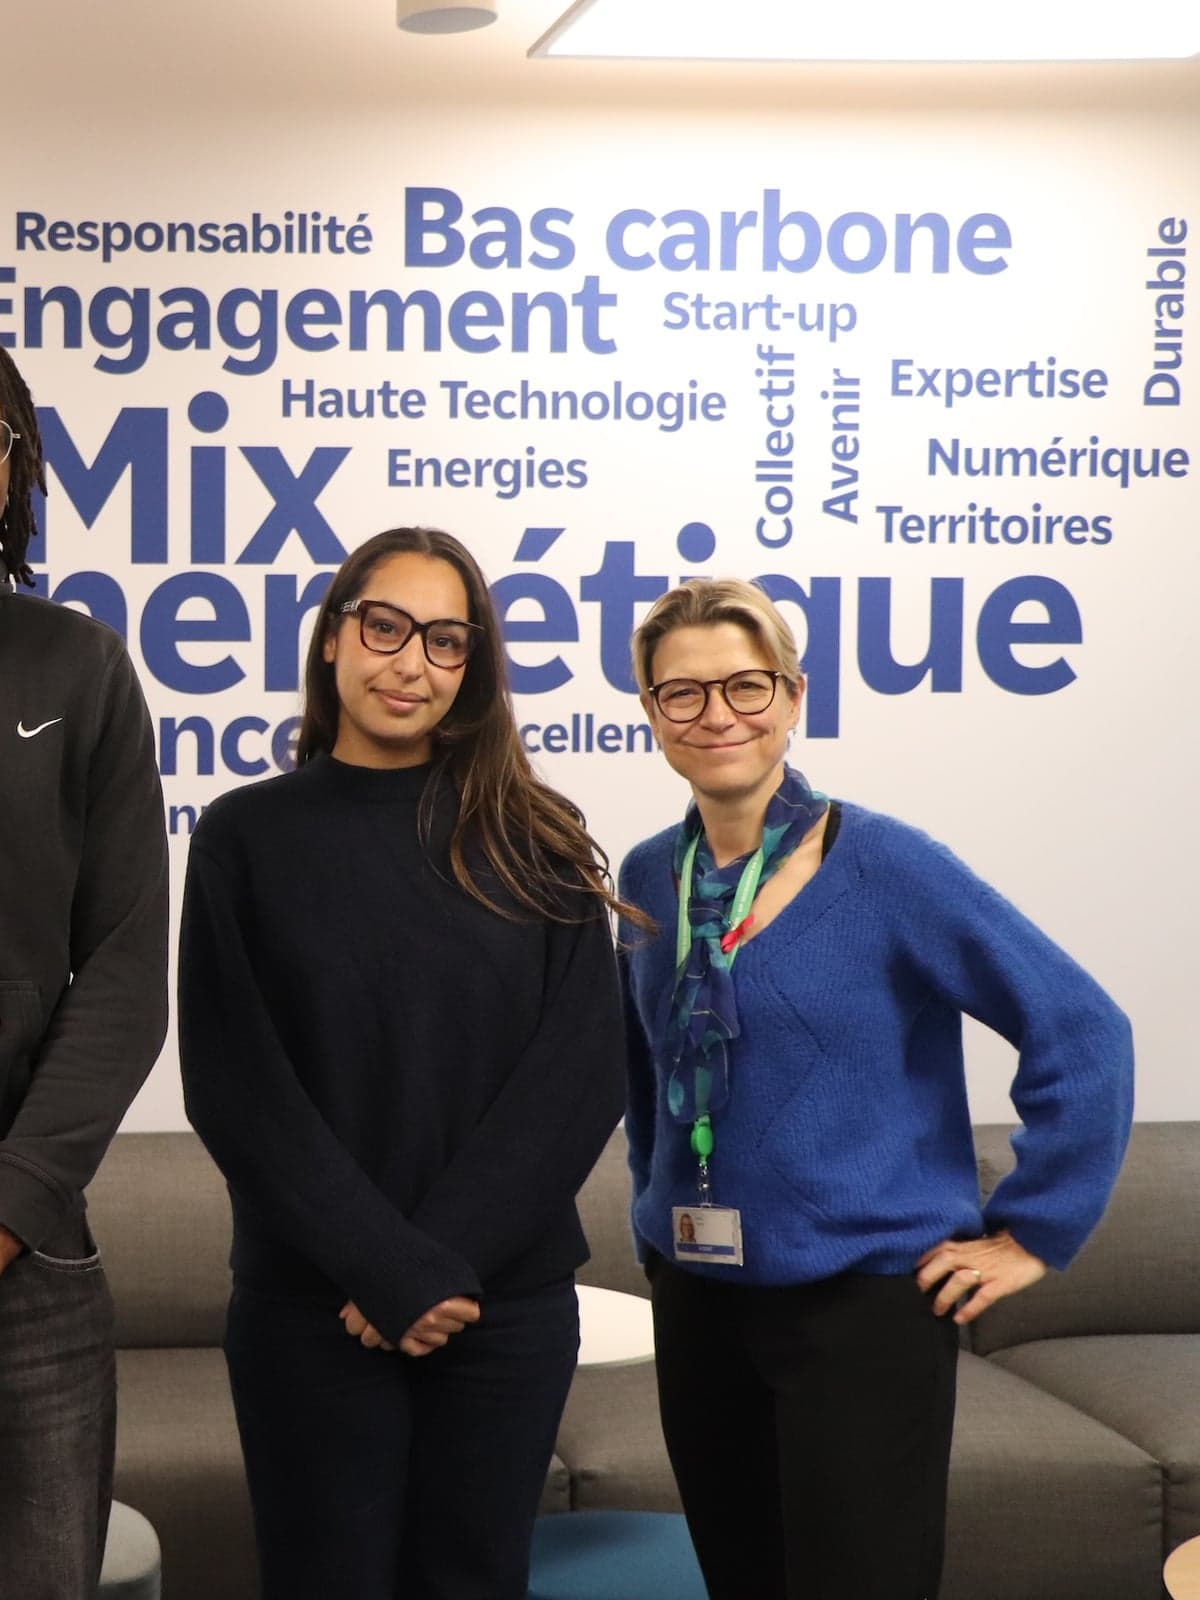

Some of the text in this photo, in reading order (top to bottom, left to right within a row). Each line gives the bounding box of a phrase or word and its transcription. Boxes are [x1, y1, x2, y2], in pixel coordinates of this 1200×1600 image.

[15, 211, 373, 263] Responsabilité
[404, 186, 1013, 276] Bas carbone
[662, 292, 858, 342] Start-up
[1143, 216, 1188, 406] Durable
[282, 379, 727, 433] Haute Technologie
[890, 356, 1109, 408] Expertise
[755, 344, 796, 549] Collectif
[820, 368, 861, 524] Avenir
[927, 436, 1190, 488] Numérique
[25, 391, 353, 565] Mix
[387, 447, 589, 499] Energies
[876, 501, 1113, 545] Territoires
